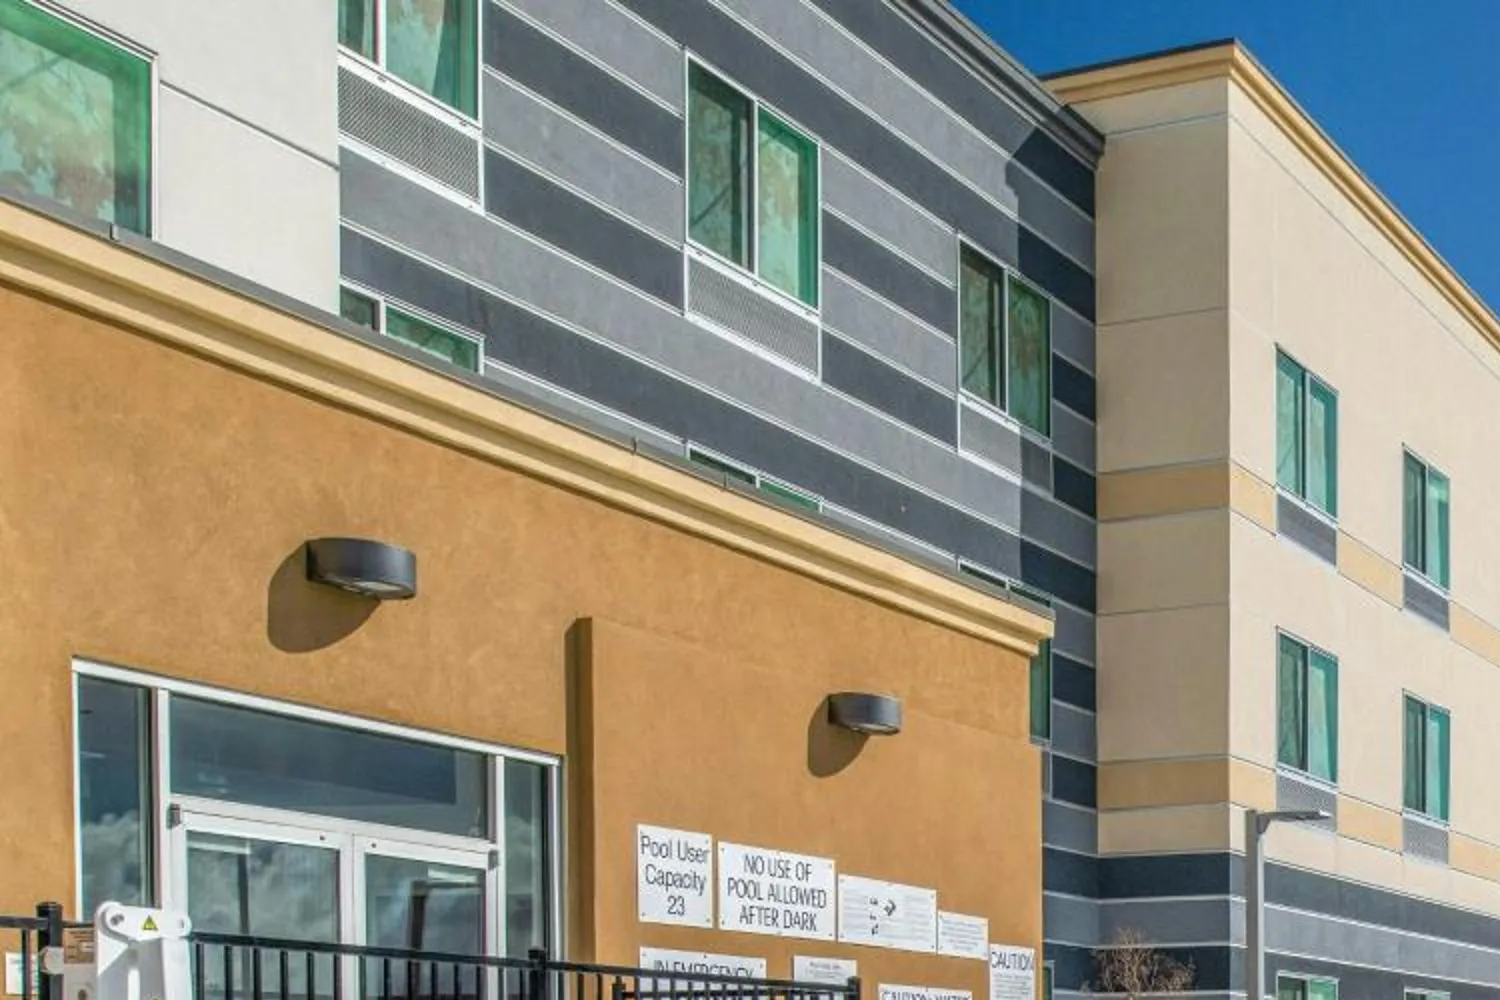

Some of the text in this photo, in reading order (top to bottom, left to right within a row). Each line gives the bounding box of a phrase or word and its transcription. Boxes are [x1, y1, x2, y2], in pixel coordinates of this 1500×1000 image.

[641, 835, 709, 864] Pool User
[645, 863, 707, 896] Capacity
[744, 854, 812, 882] NO USE OF
[667, 895, 686, 916] 23
[727, 877, 827, 910] POOL ALLOWED
[740, 905, 817, 932] AFTER DARK
[991, 951, 1034, 971] CAUTION
